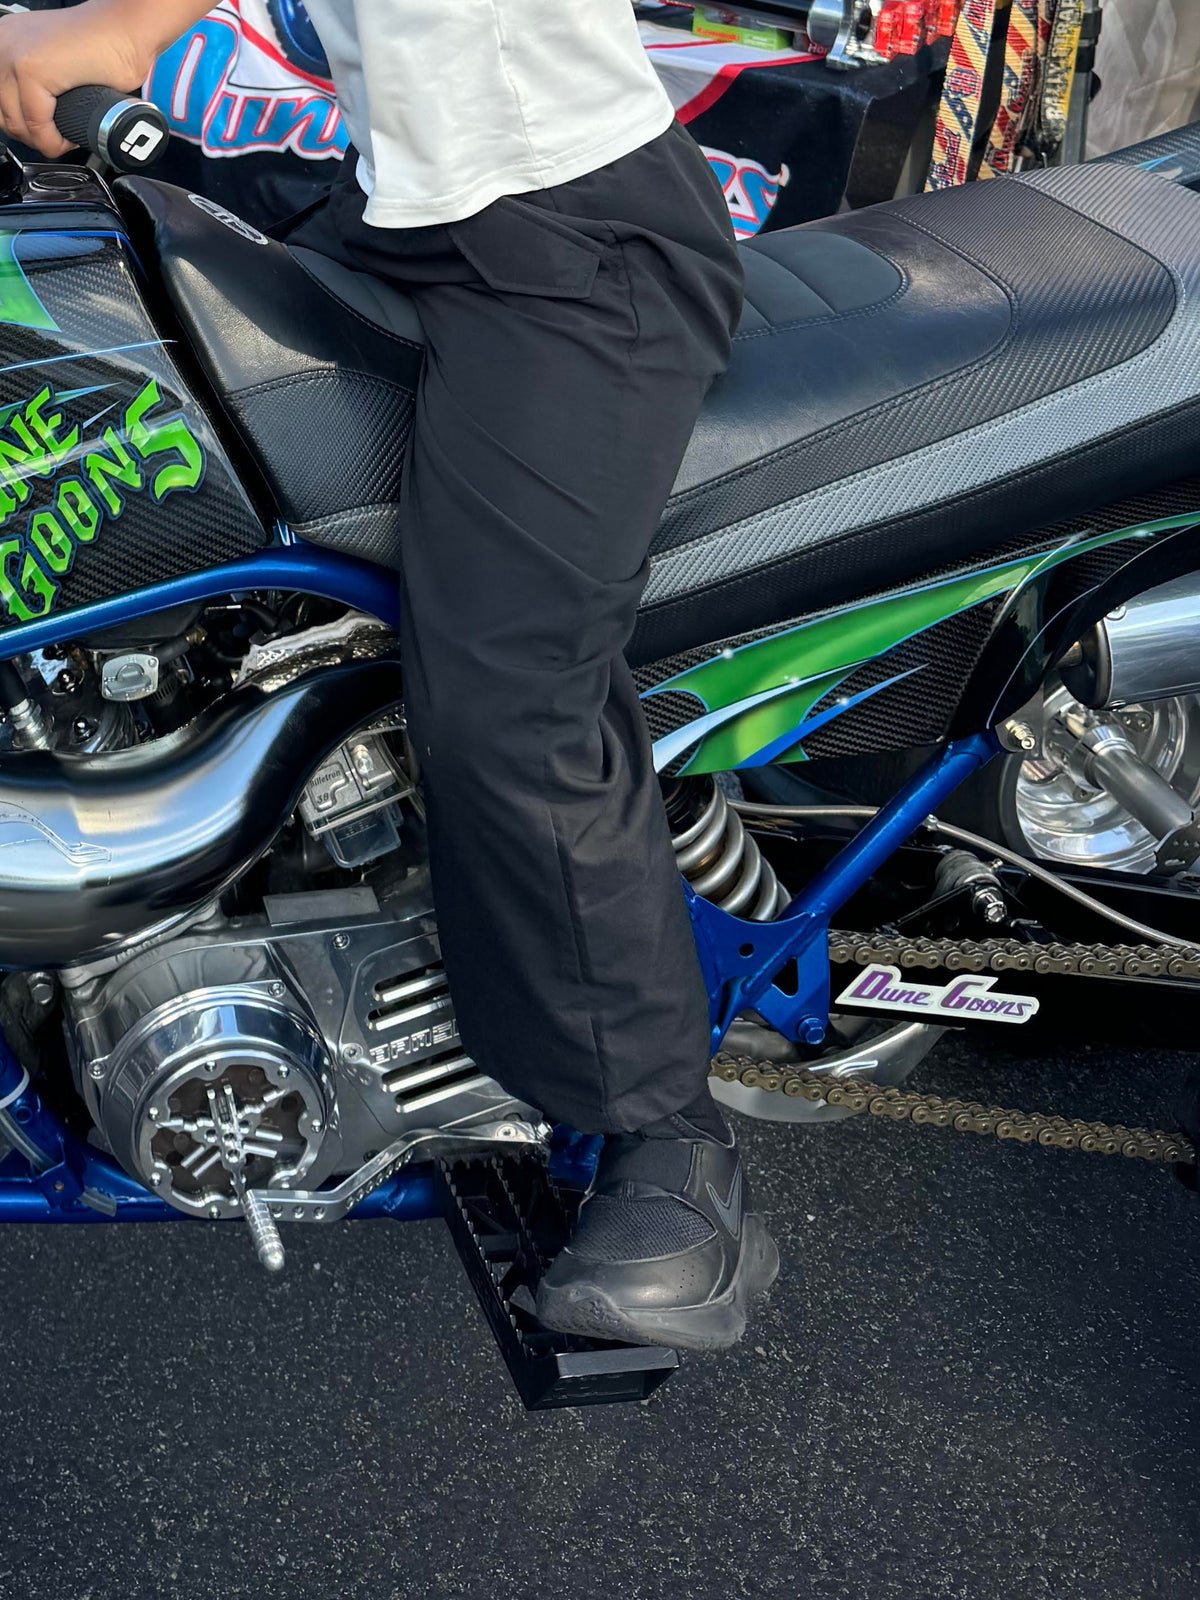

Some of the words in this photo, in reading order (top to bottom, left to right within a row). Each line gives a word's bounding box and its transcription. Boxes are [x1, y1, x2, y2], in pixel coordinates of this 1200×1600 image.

[148, 18, 351, 152] Dun
[849, 970, 932, 1006] Dune
[940, 981, 1033, 1017] Goons
